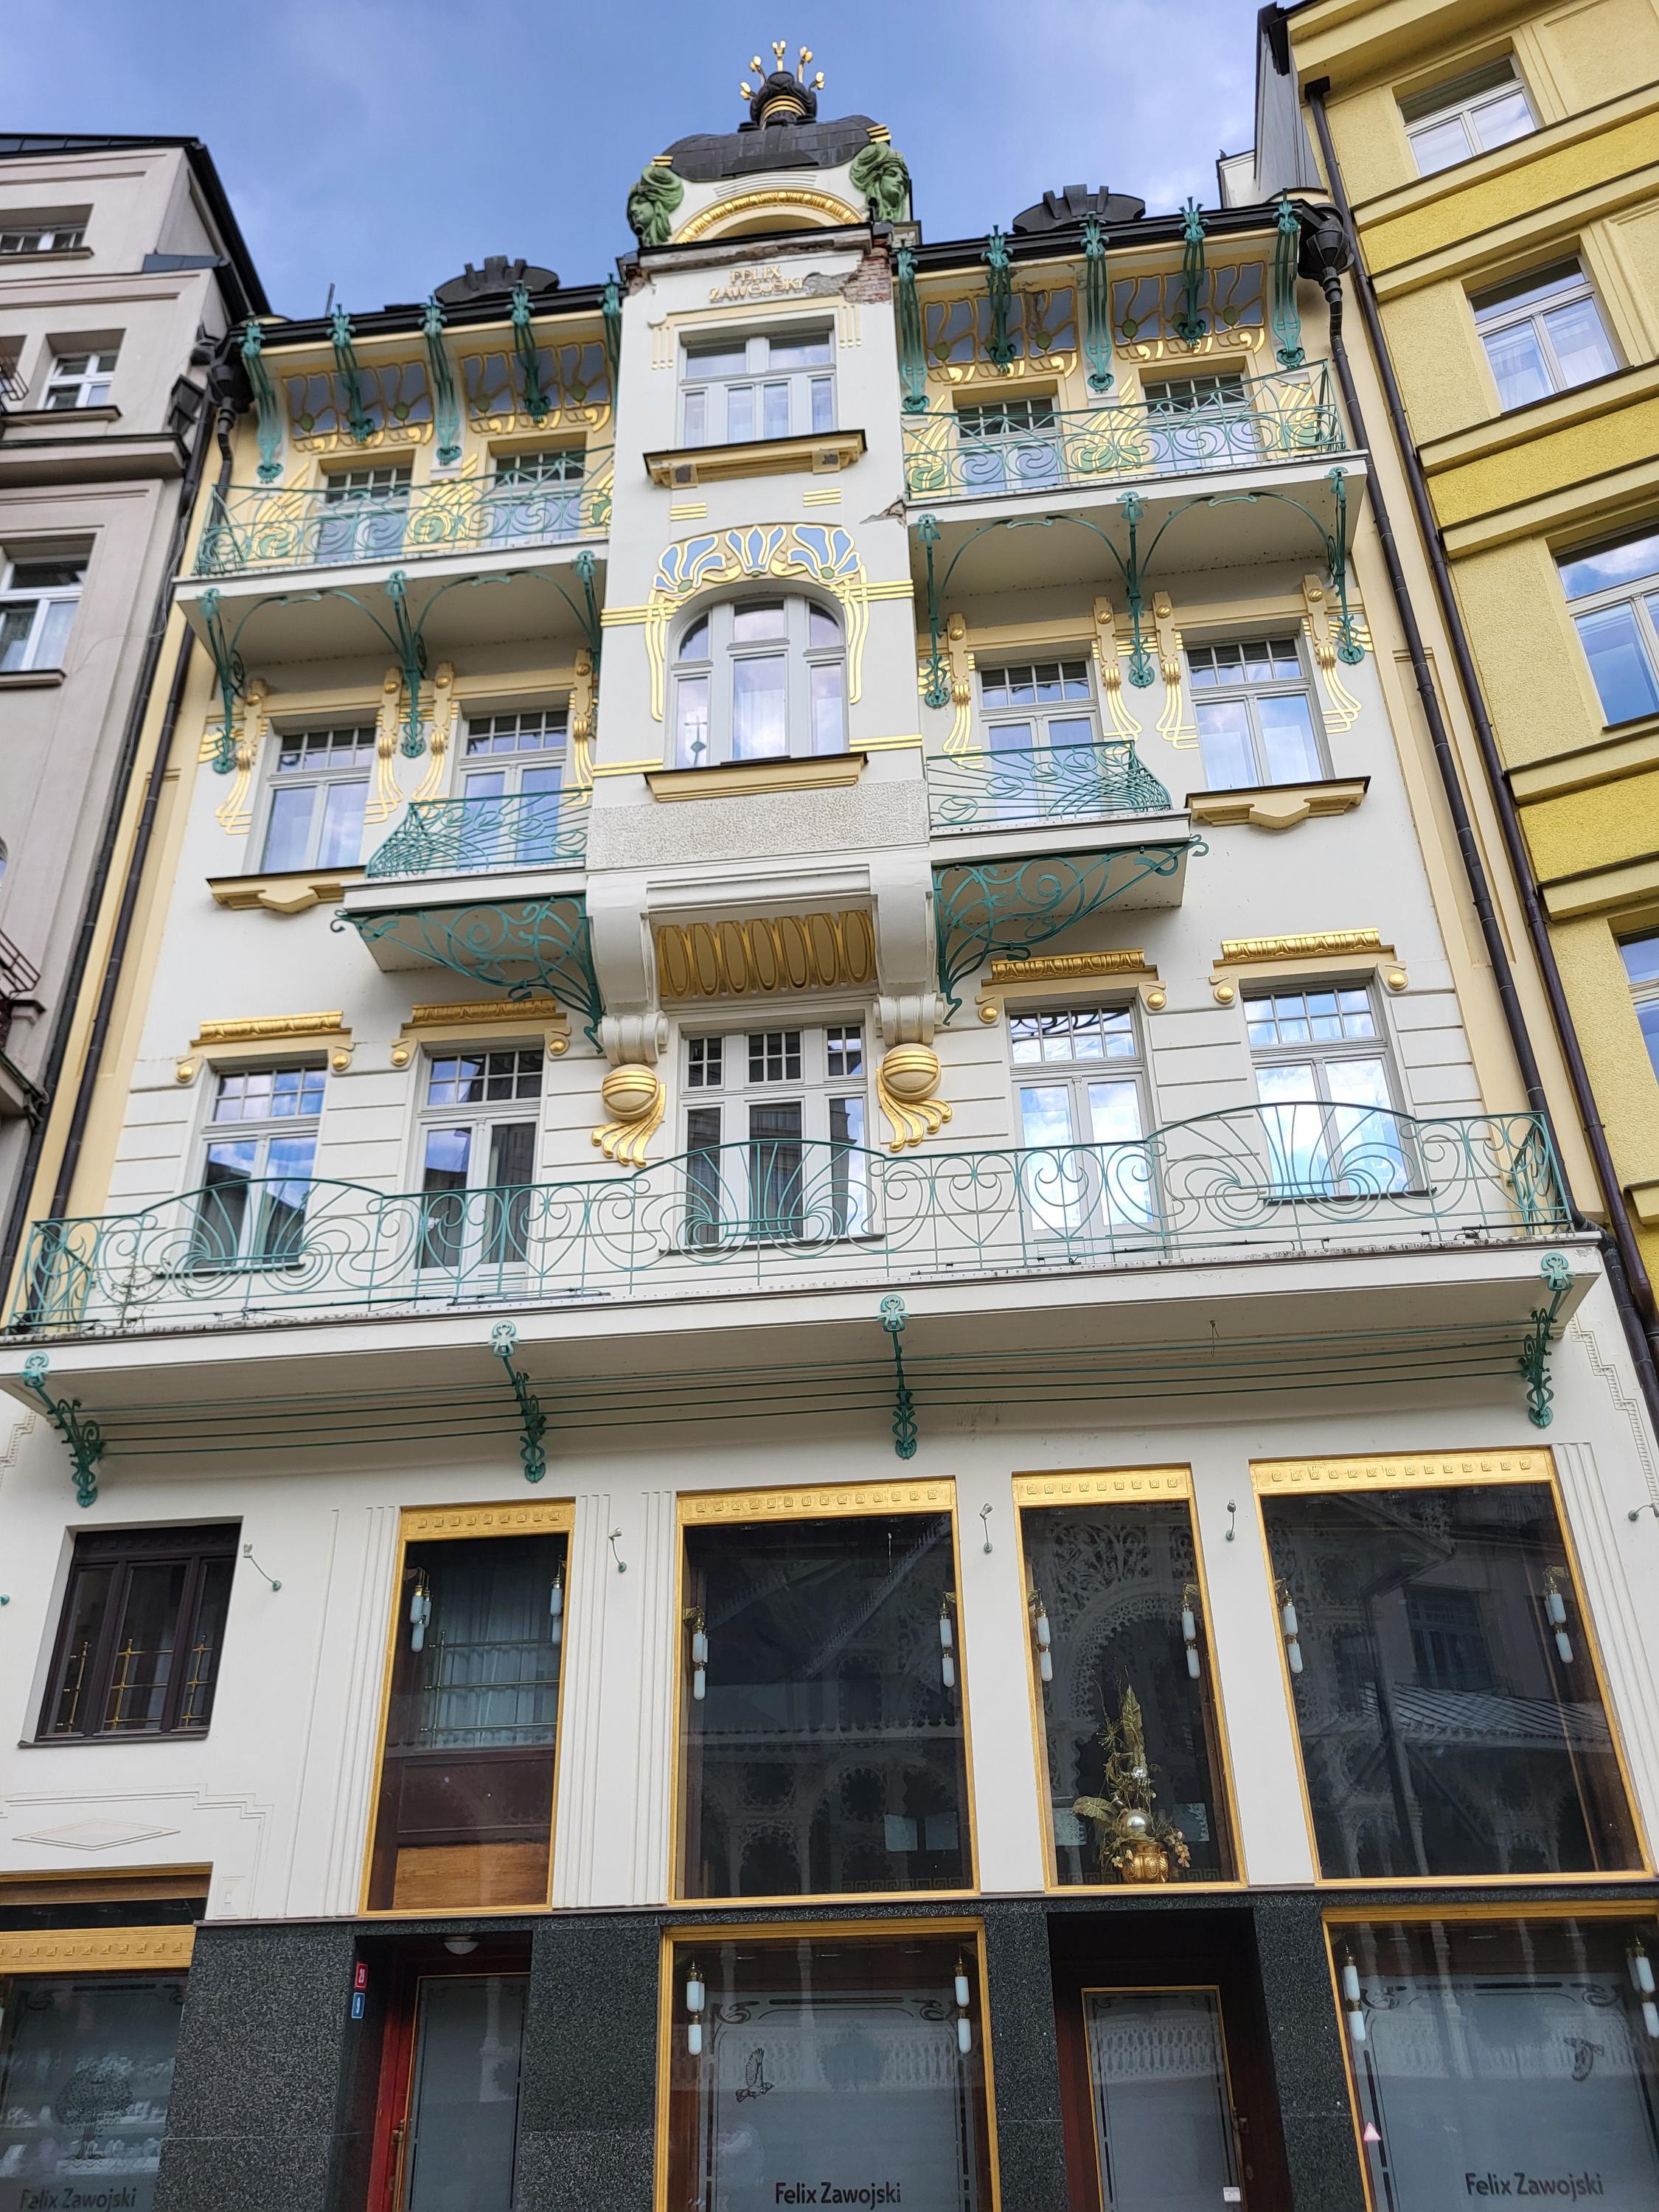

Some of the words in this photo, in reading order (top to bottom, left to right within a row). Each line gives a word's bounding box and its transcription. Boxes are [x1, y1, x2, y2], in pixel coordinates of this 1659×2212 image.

[731, 265, 781, 283] FELIX
[709, 278, 804, 300] ZAWOJSKI
[20, 2188, 58, 2210] Felix
[60, 2187, 136, 2212] Zawojski
[776, 2183, 816, 2204] Felix
[821, 2181, 901, 2211] Zawojski
[1464, 2172, 1512, 2195] Felix
[1514, 2172, 1604, 2202] Zawojski
